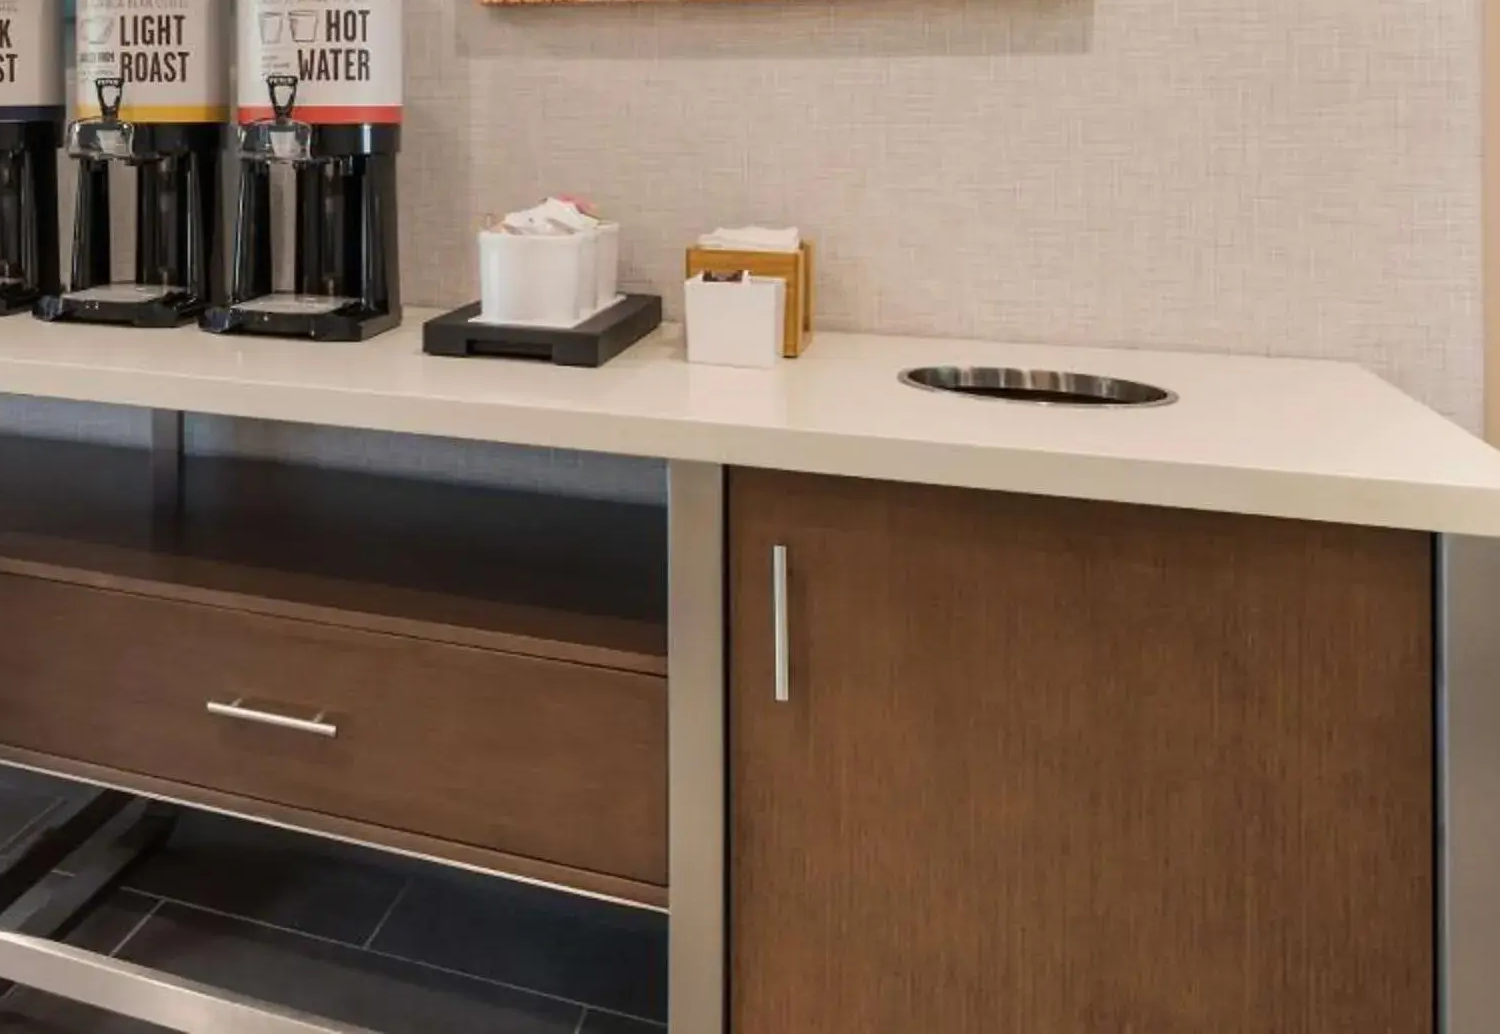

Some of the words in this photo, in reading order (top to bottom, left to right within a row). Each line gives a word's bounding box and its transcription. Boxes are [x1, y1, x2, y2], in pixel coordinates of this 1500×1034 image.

[119, 14, 187, 47] LIGHT
[325, 9, 371, 43] HOT
[120, 51, 190, 83] ROAST
[297, 48, 371, 82] WATER
